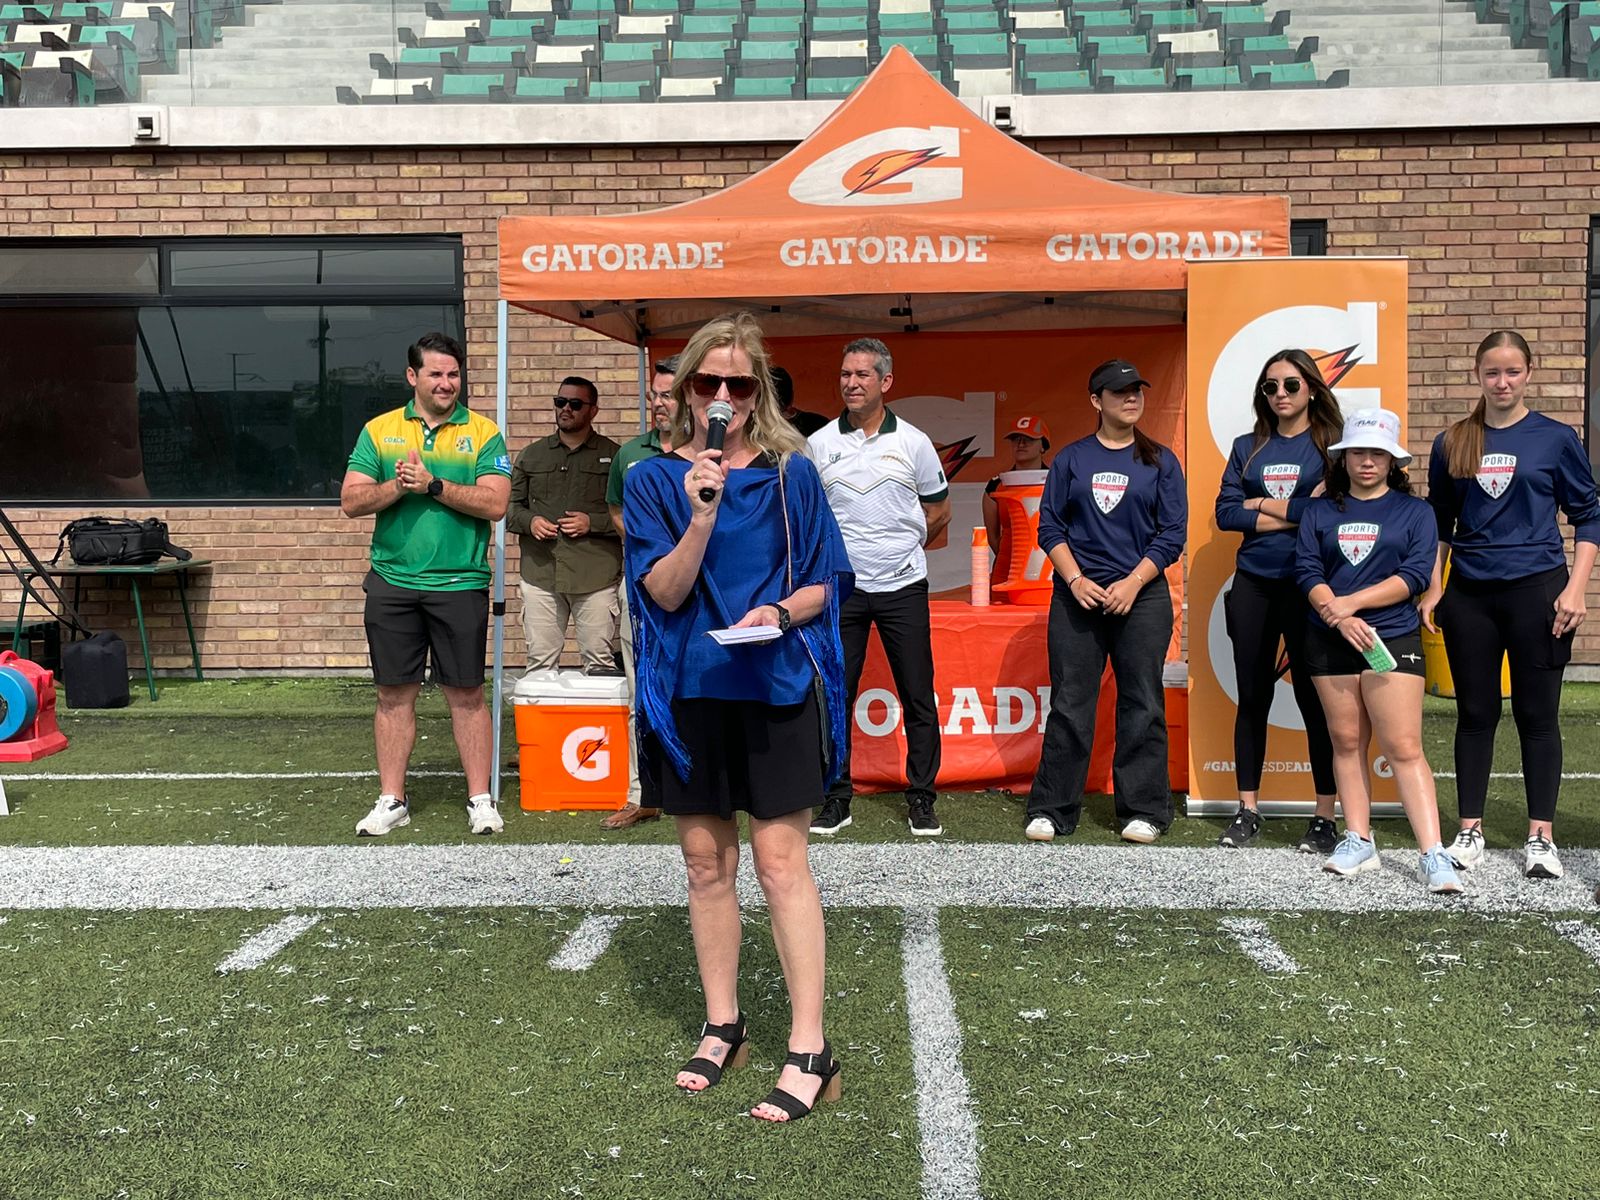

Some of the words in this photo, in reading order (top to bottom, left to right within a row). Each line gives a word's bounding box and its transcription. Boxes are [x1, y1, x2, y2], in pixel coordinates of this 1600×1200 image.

[788, 126, 963, 206] G
[521, 242, 724, 272] GATORADE
[780, 235, 987, 267] GATORADE
[1046, 230, 1262, 262] GATORADE
[1016, 417, 1031, 428] G
[1265, 465, 1299, 474] SPORTS
[1479, 456, 1514, 466] PORTS
[1095, 474, 1127, 485] SPORTS
[1341, 524, 1377, 534] SPORTS
[855, 687, 1051, 737] OAD
[561, 726, 610, 781] G
